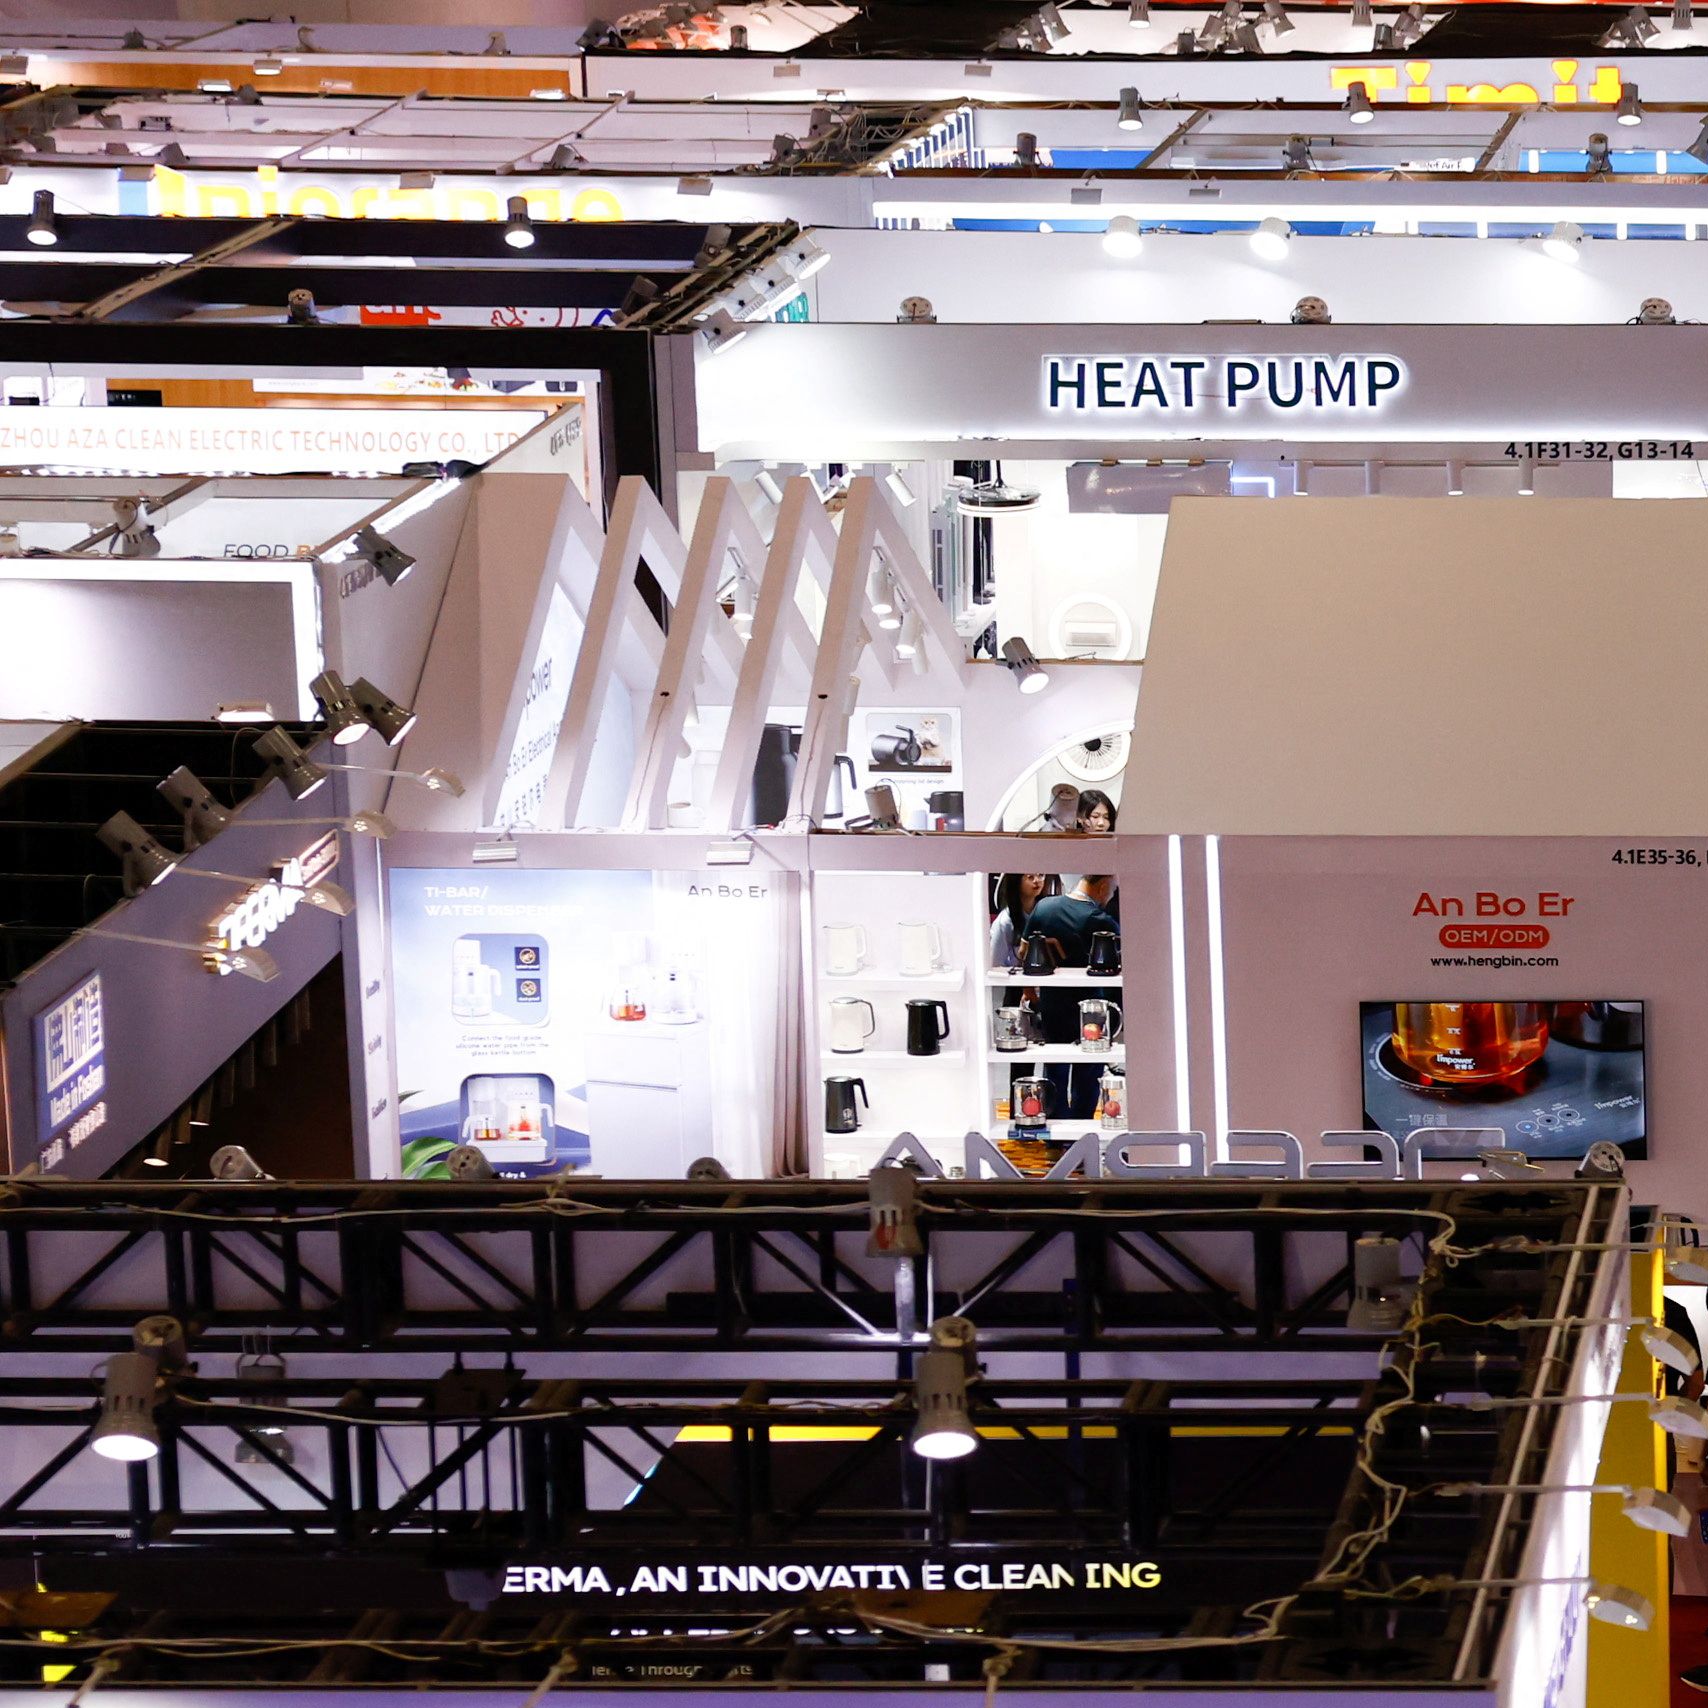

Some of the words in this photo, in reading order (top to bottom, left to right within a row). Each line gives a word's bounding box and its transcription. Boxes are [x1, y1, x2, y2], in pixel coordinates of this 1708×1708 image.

[1048, 360, 1203, 409] HEAT
[1227, 357, 1402, 409] PUMP
[67, 428, 108, 449] AZA
[115, 429, 181, 450] CLEAN
[190, 429, 283, 451] ELECTRIC
[290, 430, 430, 453] TECHNOLOGY
[1617, 442, 1694, 460] G13-14
[224, 544, 289, 558] FOOD
[1611, 848, 1702, 867] 4.1E35-36,
[688, 885, 712, 899] An
[718, 885, 742, 899] Bo
[749, 885, 768, 899] Er
[1412, 892, 1464, 917] An
[1476, 892, 1526, 917] Bo
[1539, 892, 1575, 917] Er
[1445, 929, 1544, 944] OEM/ODM
[1430, 955, 1559, 969] www.hengbin.com
[629, 1565, 688, 1593] AN
[953, 1561, 1162, 1590] CLEANING
